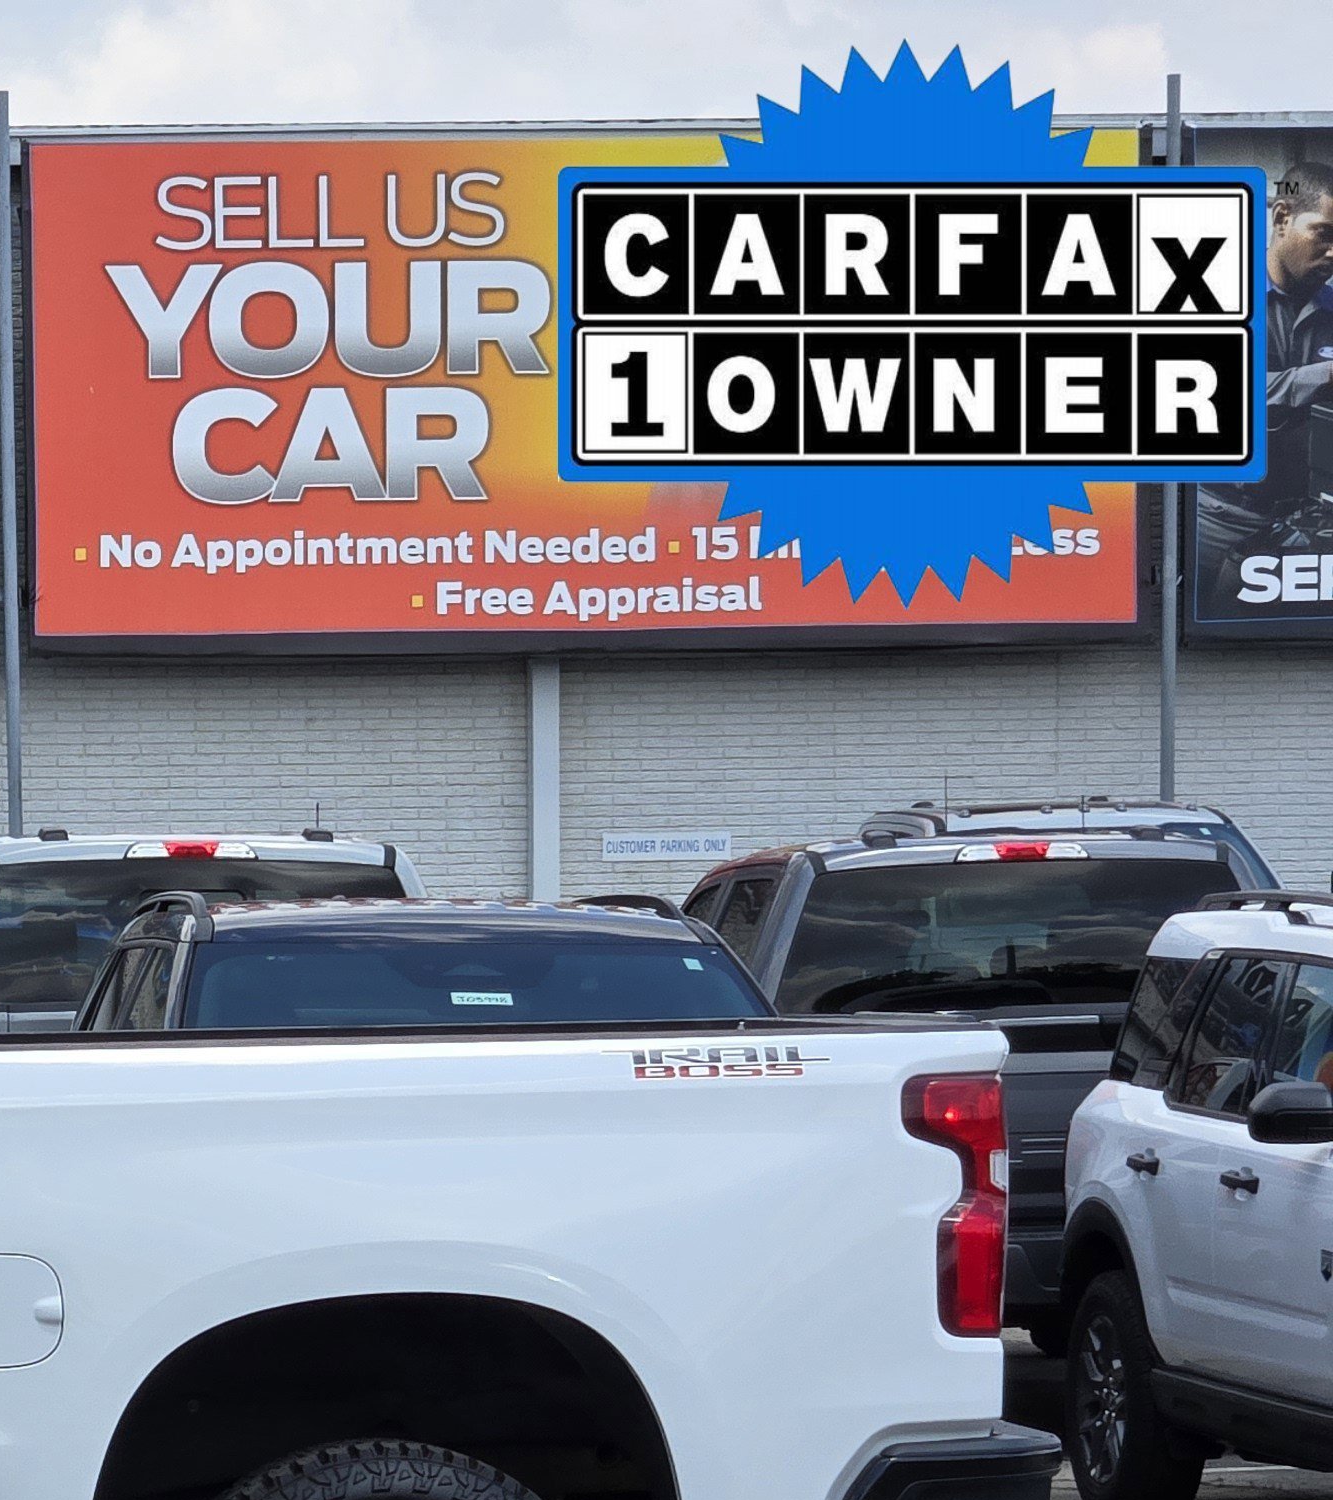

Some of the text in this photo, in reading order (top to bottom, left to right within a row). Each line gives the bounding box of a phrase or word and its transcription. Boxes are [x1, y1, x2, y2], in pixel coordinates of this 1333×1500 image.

[155, 171, 506, 251] SELL US
[104, 260, 551, 379] YOUR
[172, 386, 489, 505] CAR
[99, 533, 162, 569] No
[171, 527, 473, 574] Appointment
[485, 526, 656, 566] Needed
[692, 527, 739, 560] 15
[436, 576, 763, 621] Free Appraisal
[606, 838, 726, 853] CUSTOMER PARKING ONLY
[601, 1046, 830, 1065] TRAIL
[634, 1063, 804, 1079] BOSS
